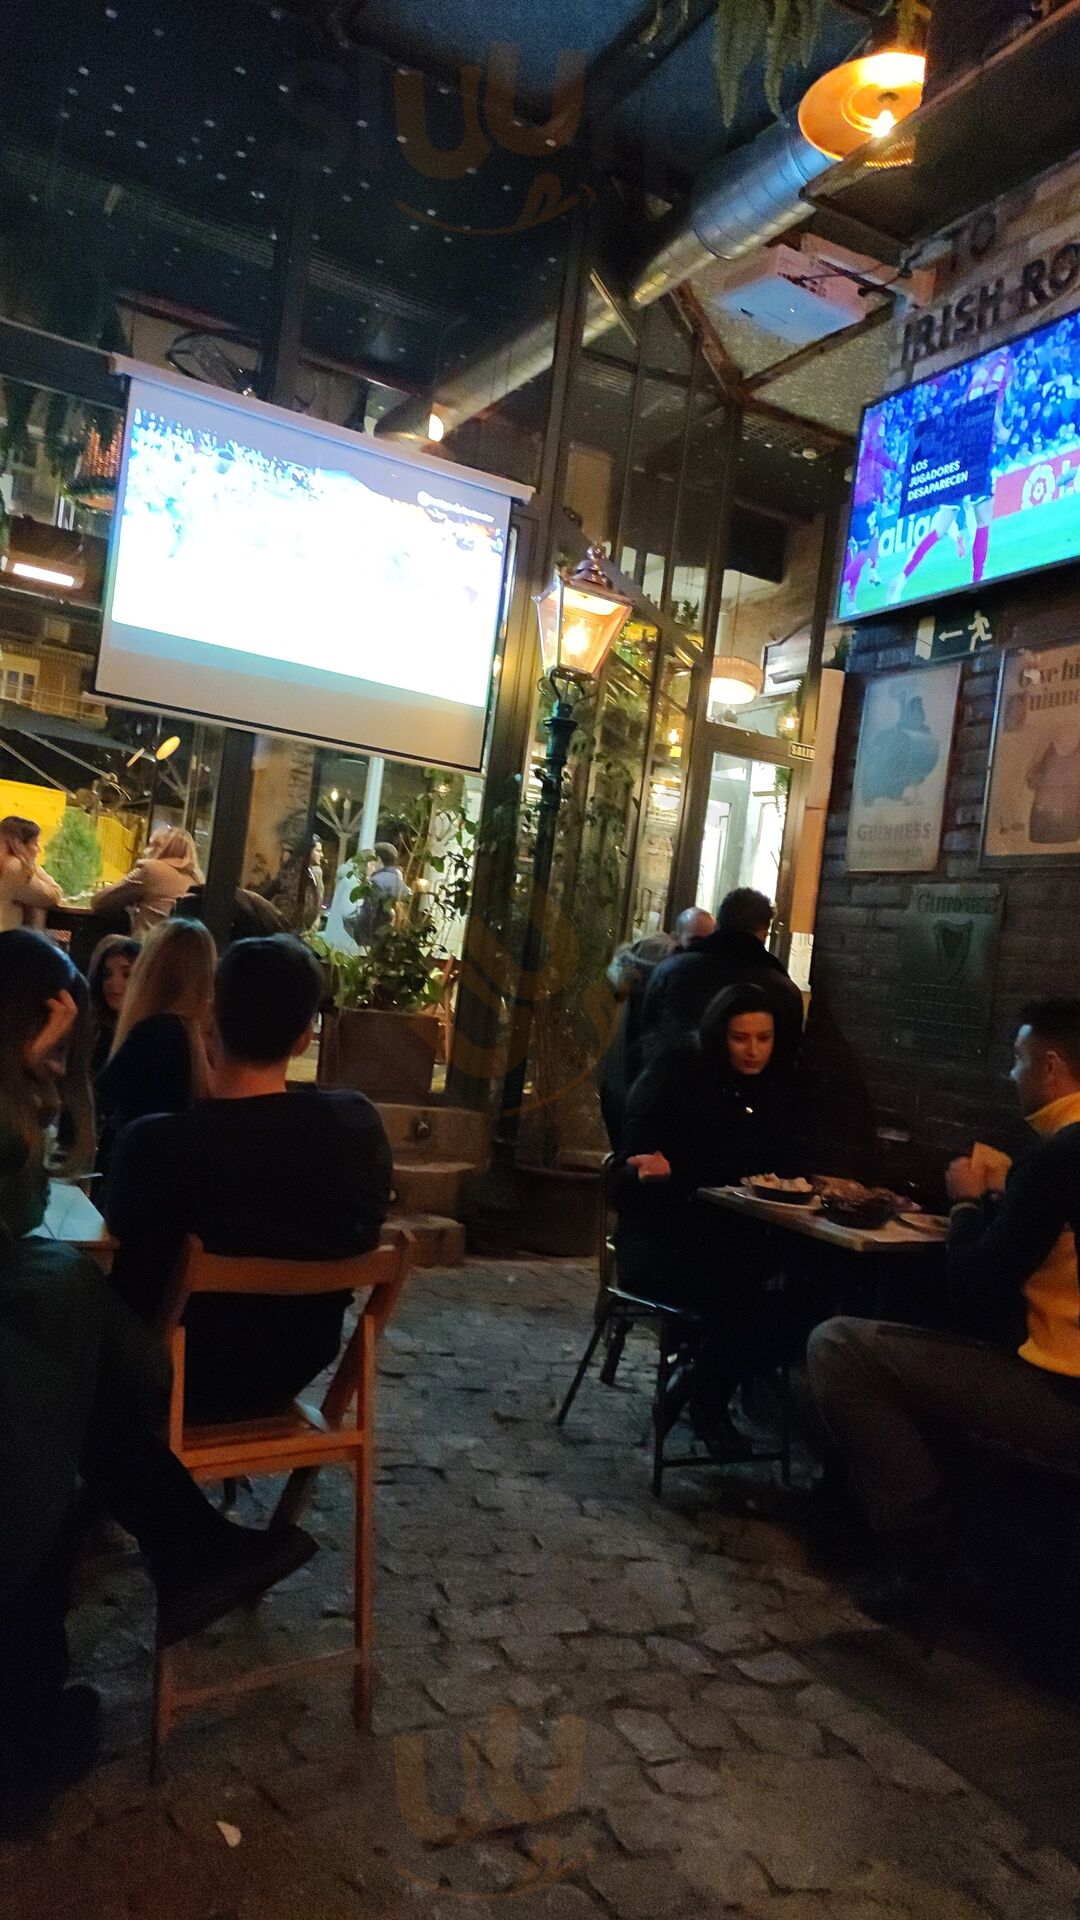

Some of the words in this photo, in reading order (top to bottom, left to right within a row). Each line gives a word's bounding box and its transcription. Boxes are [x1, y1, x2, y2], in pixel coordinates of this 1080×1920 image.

[902, 278, 1004, 366] IRISH
[908, 460, 961, 488] JUGADORES
[910, 459, 928, 474] LOS
[907, 471, 969, 501] DESAPARECEN
